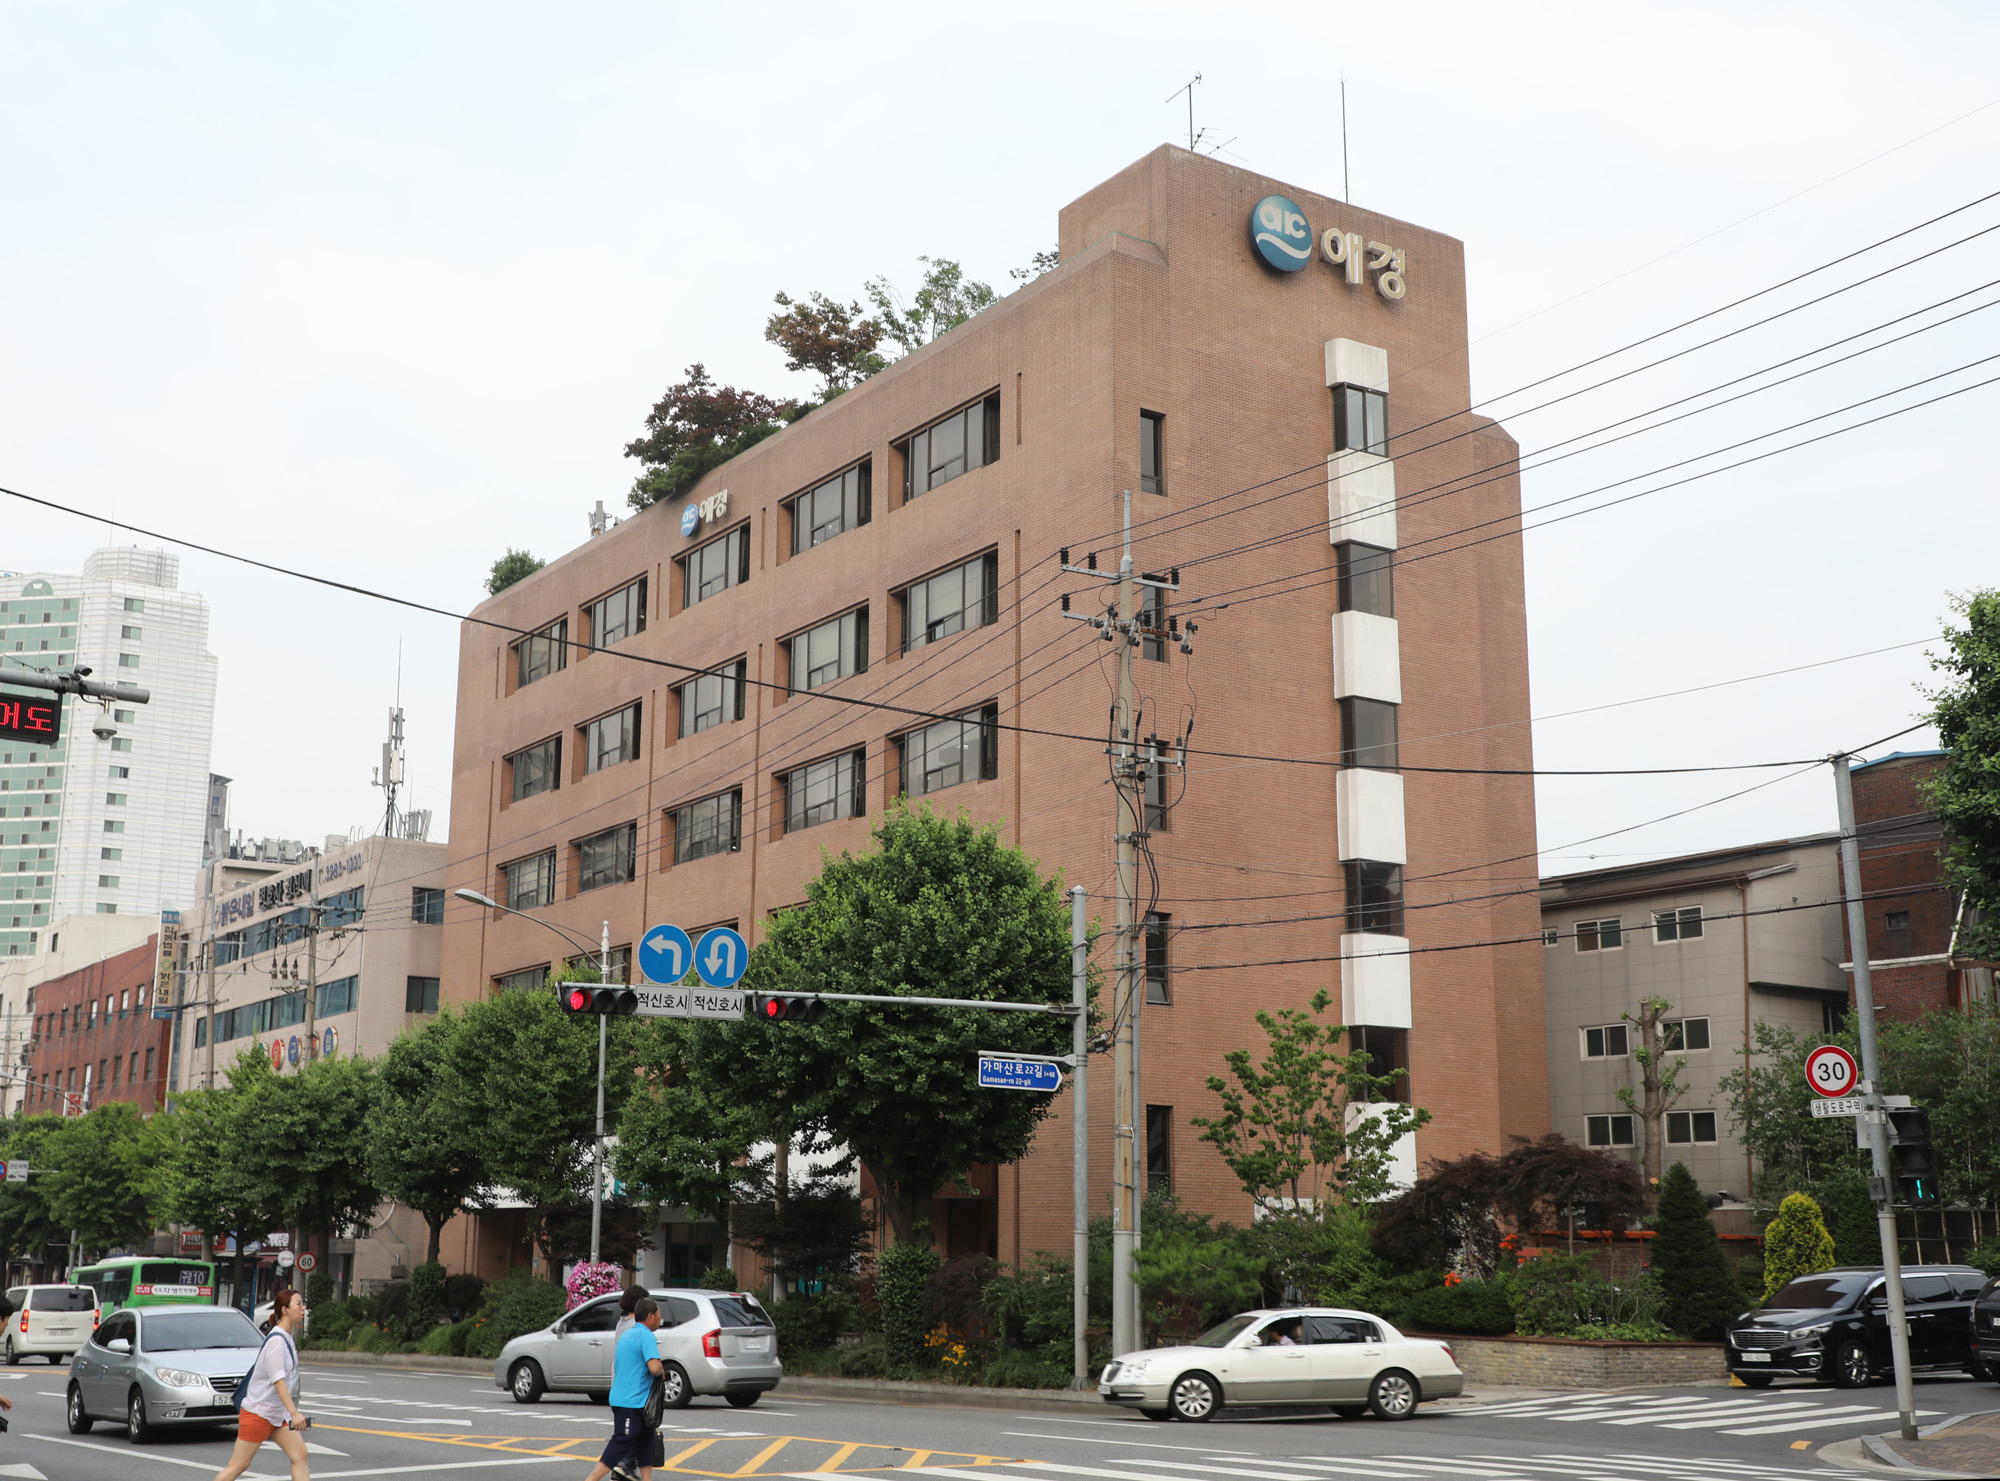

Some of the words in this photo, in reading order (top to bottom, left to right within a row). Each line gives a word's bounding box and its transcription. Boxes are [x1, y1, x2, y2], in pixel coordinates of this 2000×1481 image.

[1320, 227, 1406, 300] 애경
[699, 488, 728, 524] 애경
[220, 890, 255, 927] 밝은내일
[637, 992, 688, 1010] 적신호시
[693, 995, 743, 1013] 적신호시
[1817, 1061, 1845, 1082] 30
[982, 1075, 1015, 1085] Gamasan-ro
[1015, 1077, 1032, 1087] 22-gil
[1815, 1101, 1861, 1115] 생활도로구역
[301, 1257, 312, 1267] 60
